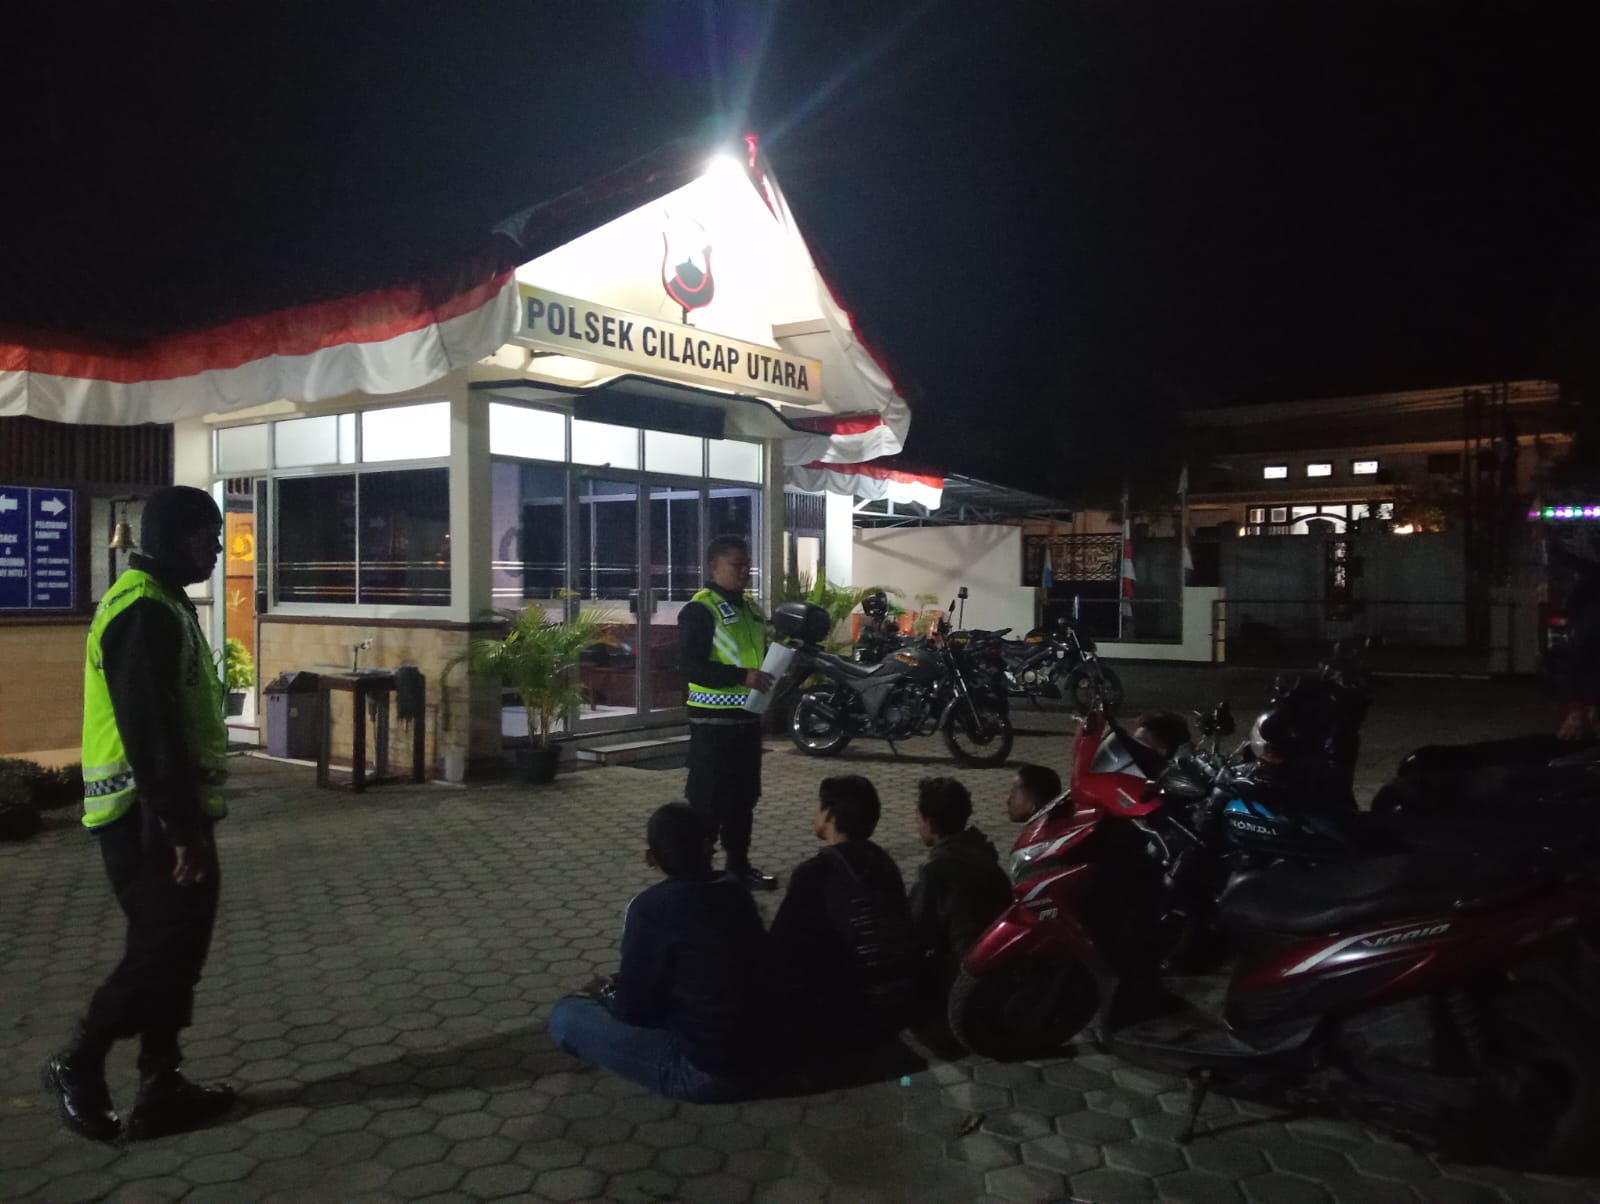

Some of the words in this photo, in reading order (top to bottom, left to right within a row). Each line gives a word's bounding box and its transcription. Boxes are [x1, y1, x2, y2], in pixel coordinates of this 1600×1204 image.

[528, 297, 633, 351] POLSEK
[643, 327, 739, 373] CILACAP
[747, 352, 808, 391] UTARA
[1229, 819, 1277, 836] HONDA
